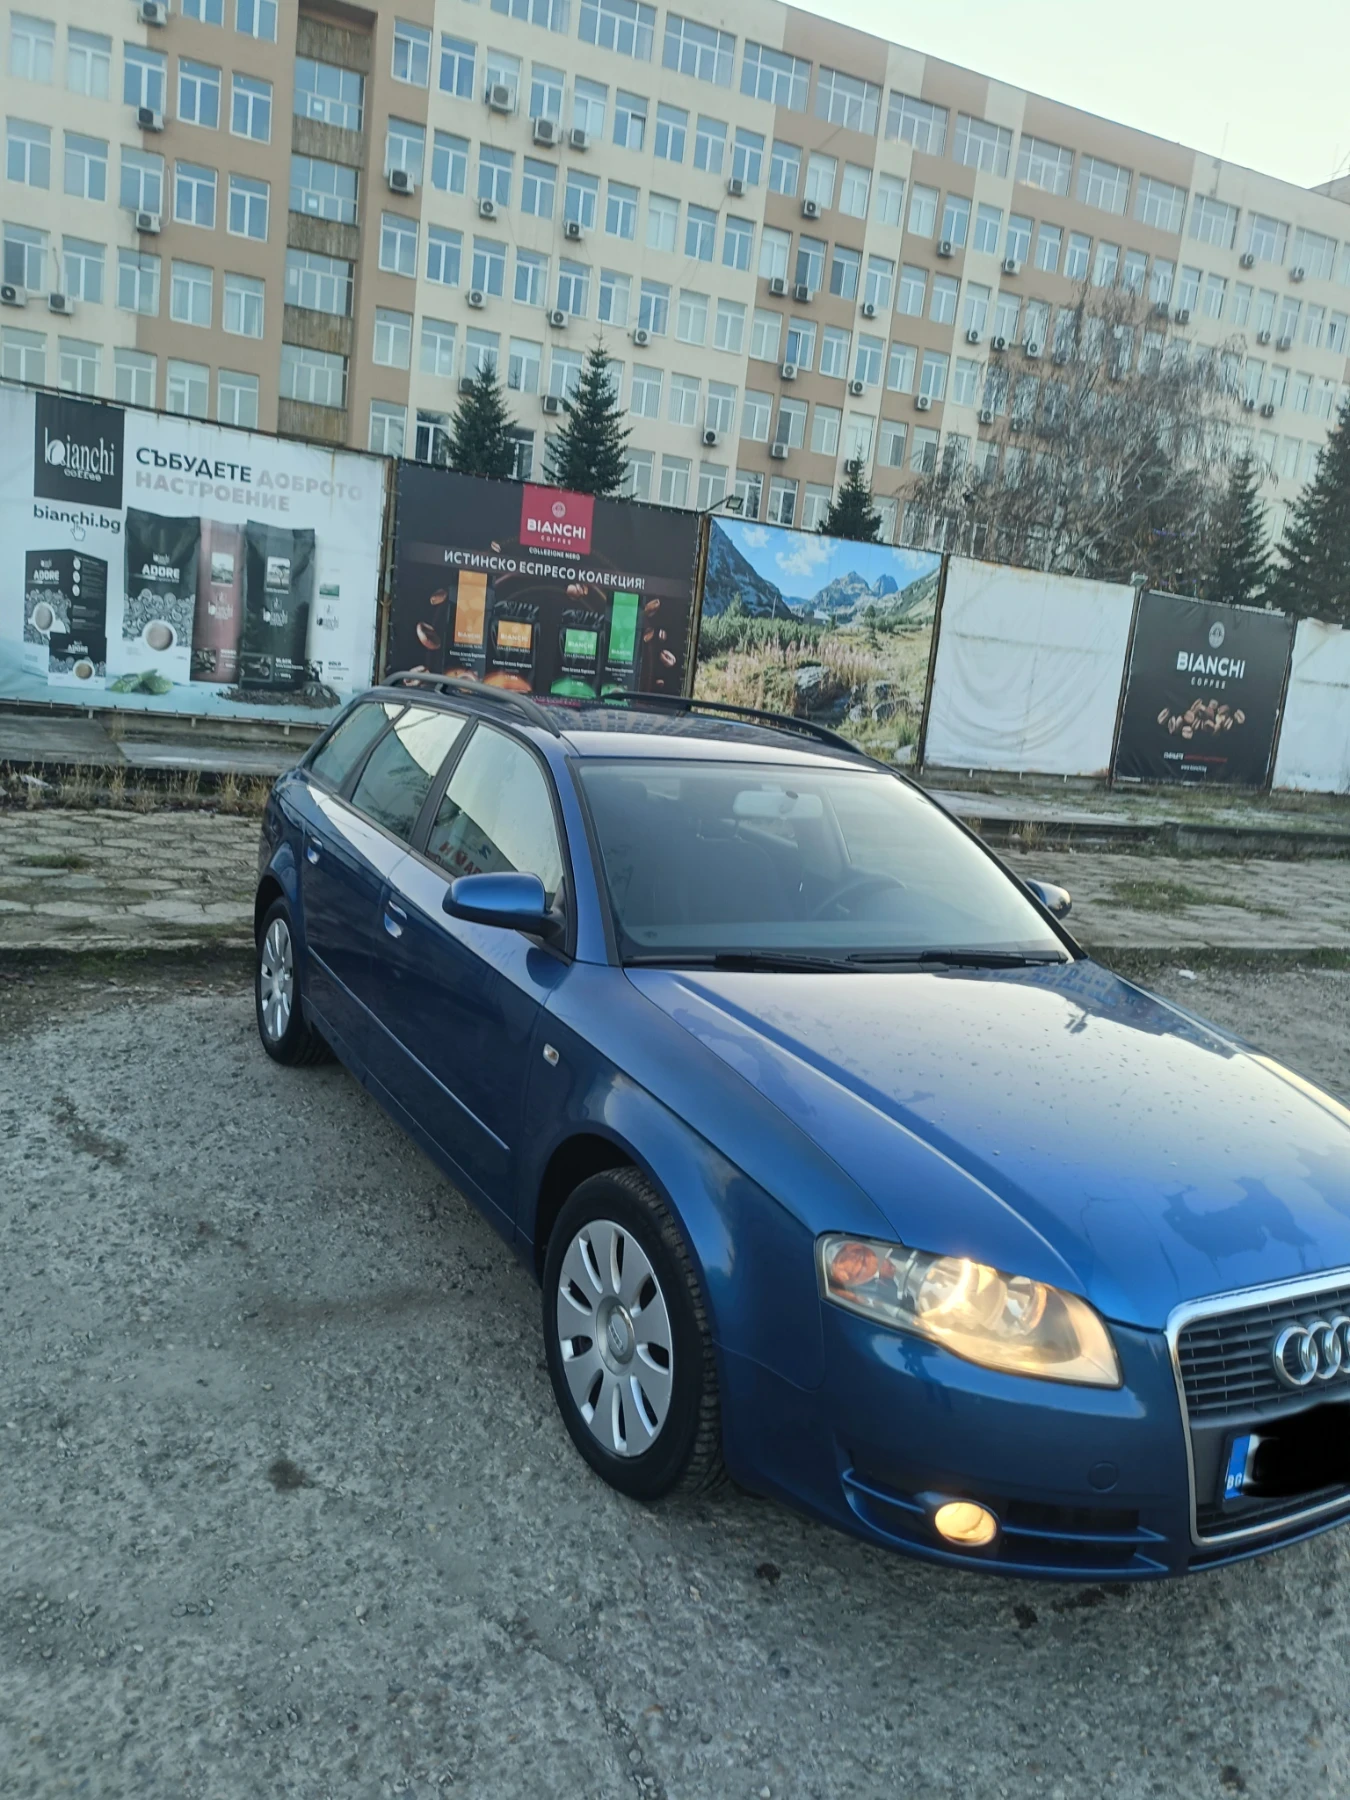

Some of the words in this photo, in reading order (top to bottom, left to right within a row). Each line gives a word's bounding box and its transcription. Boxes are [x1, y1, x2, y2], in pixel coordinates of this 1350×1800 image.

[44, 427, 115, 476] bianchi
[136, 447, 252, 483] СЪБУДЕТЕ
[256, 470, 363, 501] ДОБРОТО
[135, 471, 290, 512] НАСТРОЕНИЕ
[33, 504, 121, 534] bianchi.bg
[527, 518, 586, 540] BIANCHI
[444, 550, 516, 572] ИСТИНСКО
[519, 561, 576, 580] ЕСПРЕСО
[578, 570, 645, 590] КОЛЕКЦИЯ!
[565, 552, 581, 561] NERO
[142, 564, 180, 580] ADORE
[1176, 651, 1246, 679] BIANCHI
[1227, 1472, 1243, 1489] BG
